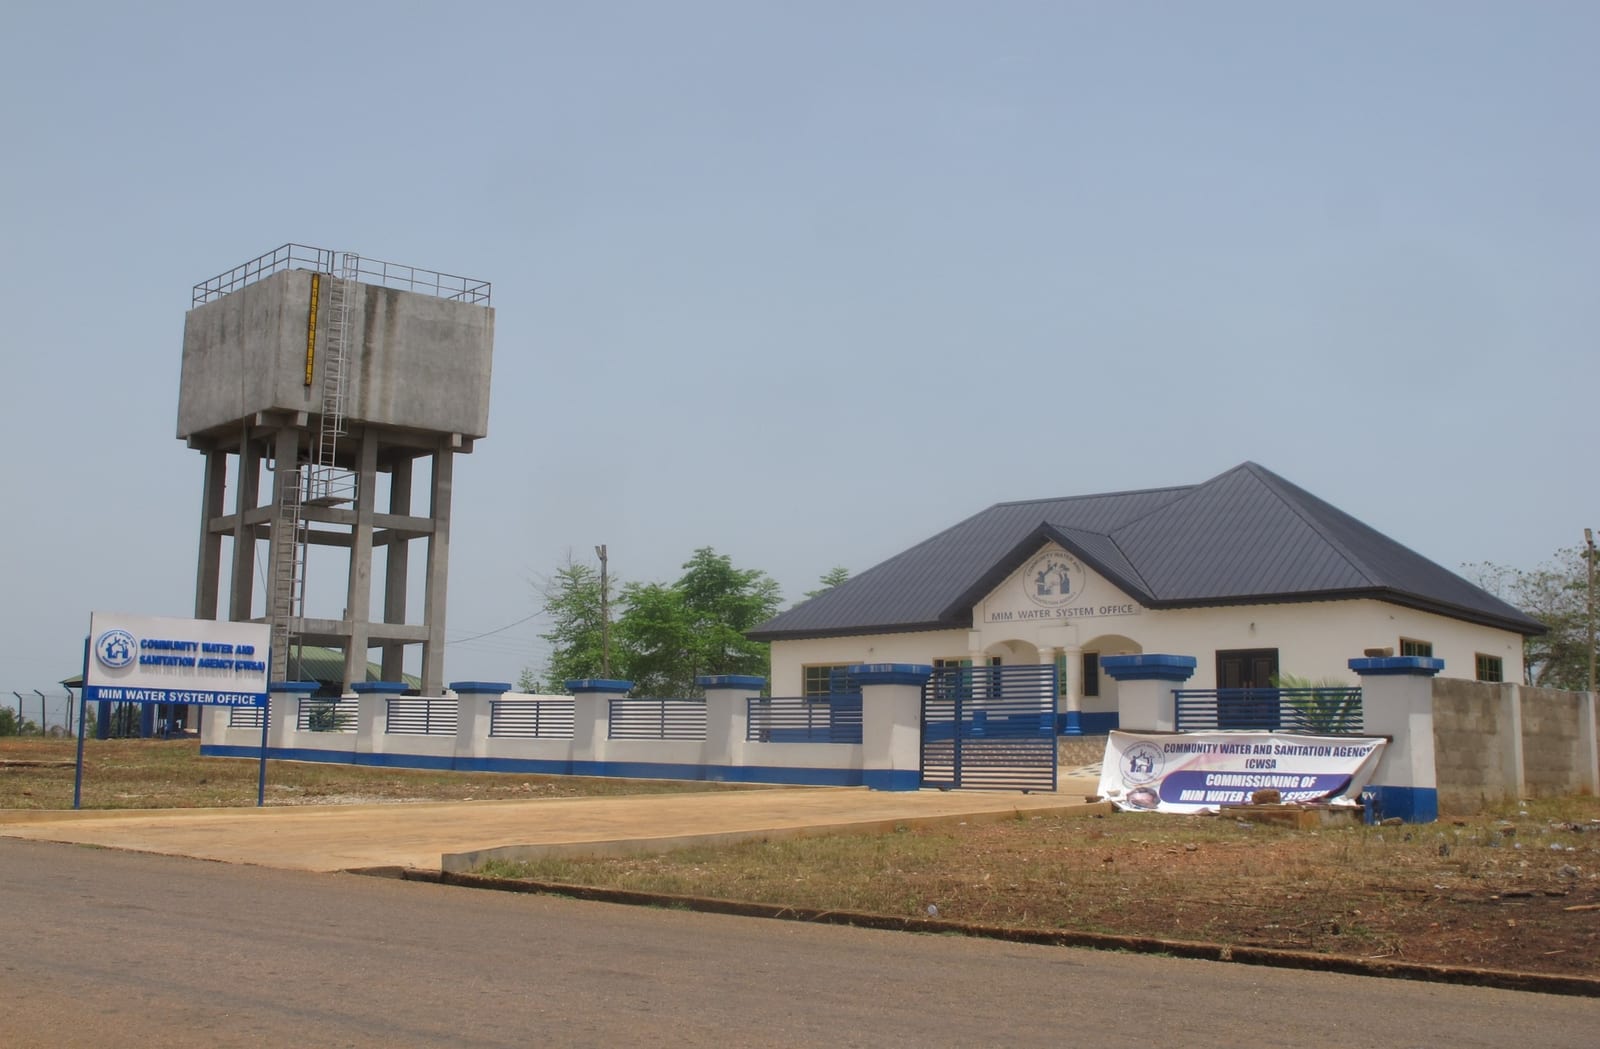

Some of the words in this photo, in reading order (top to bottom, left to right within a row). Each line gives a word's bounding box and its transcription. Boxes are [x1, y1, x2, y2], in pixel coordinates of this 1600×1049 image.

[991, 611, 1013, 621] MIM
[1017, 609, 1051, 619] WATER
[1055, 607, 1094, 617] SYSTEM
[1099, 604, 1133, 615] OFFICE
[140, 638, 199, 652] COMMUNITY
[201, 642, 234, 655] WATER
[235, 644, 255, 656] AND
[139, 655, 196, 668] SANITATION
[197, 658, 234, 670] AGENCY
[234, 660, 265, 673] (CWSA)
[98, 688, 123, 700] MIM
[125, 690, 166, 702] WATER
[169, 692, 214, 704] SYSTEM
[216, 694, 257, 706] OFFICE
[1163, 743, 1218, 755] COMMUNITY
[1219, 744, 1252, 755] WATER
[1252, 744, 1273, 756] AND
[1273, 745, 1332, 758] SANITATION
[1205, 774, 1300, 789] COMMISSIONING
[1300, 776, 1317, 788] OF
[1180, 789, 1206, 801] MIM
[1206, 790, 1245, 802] WATER
